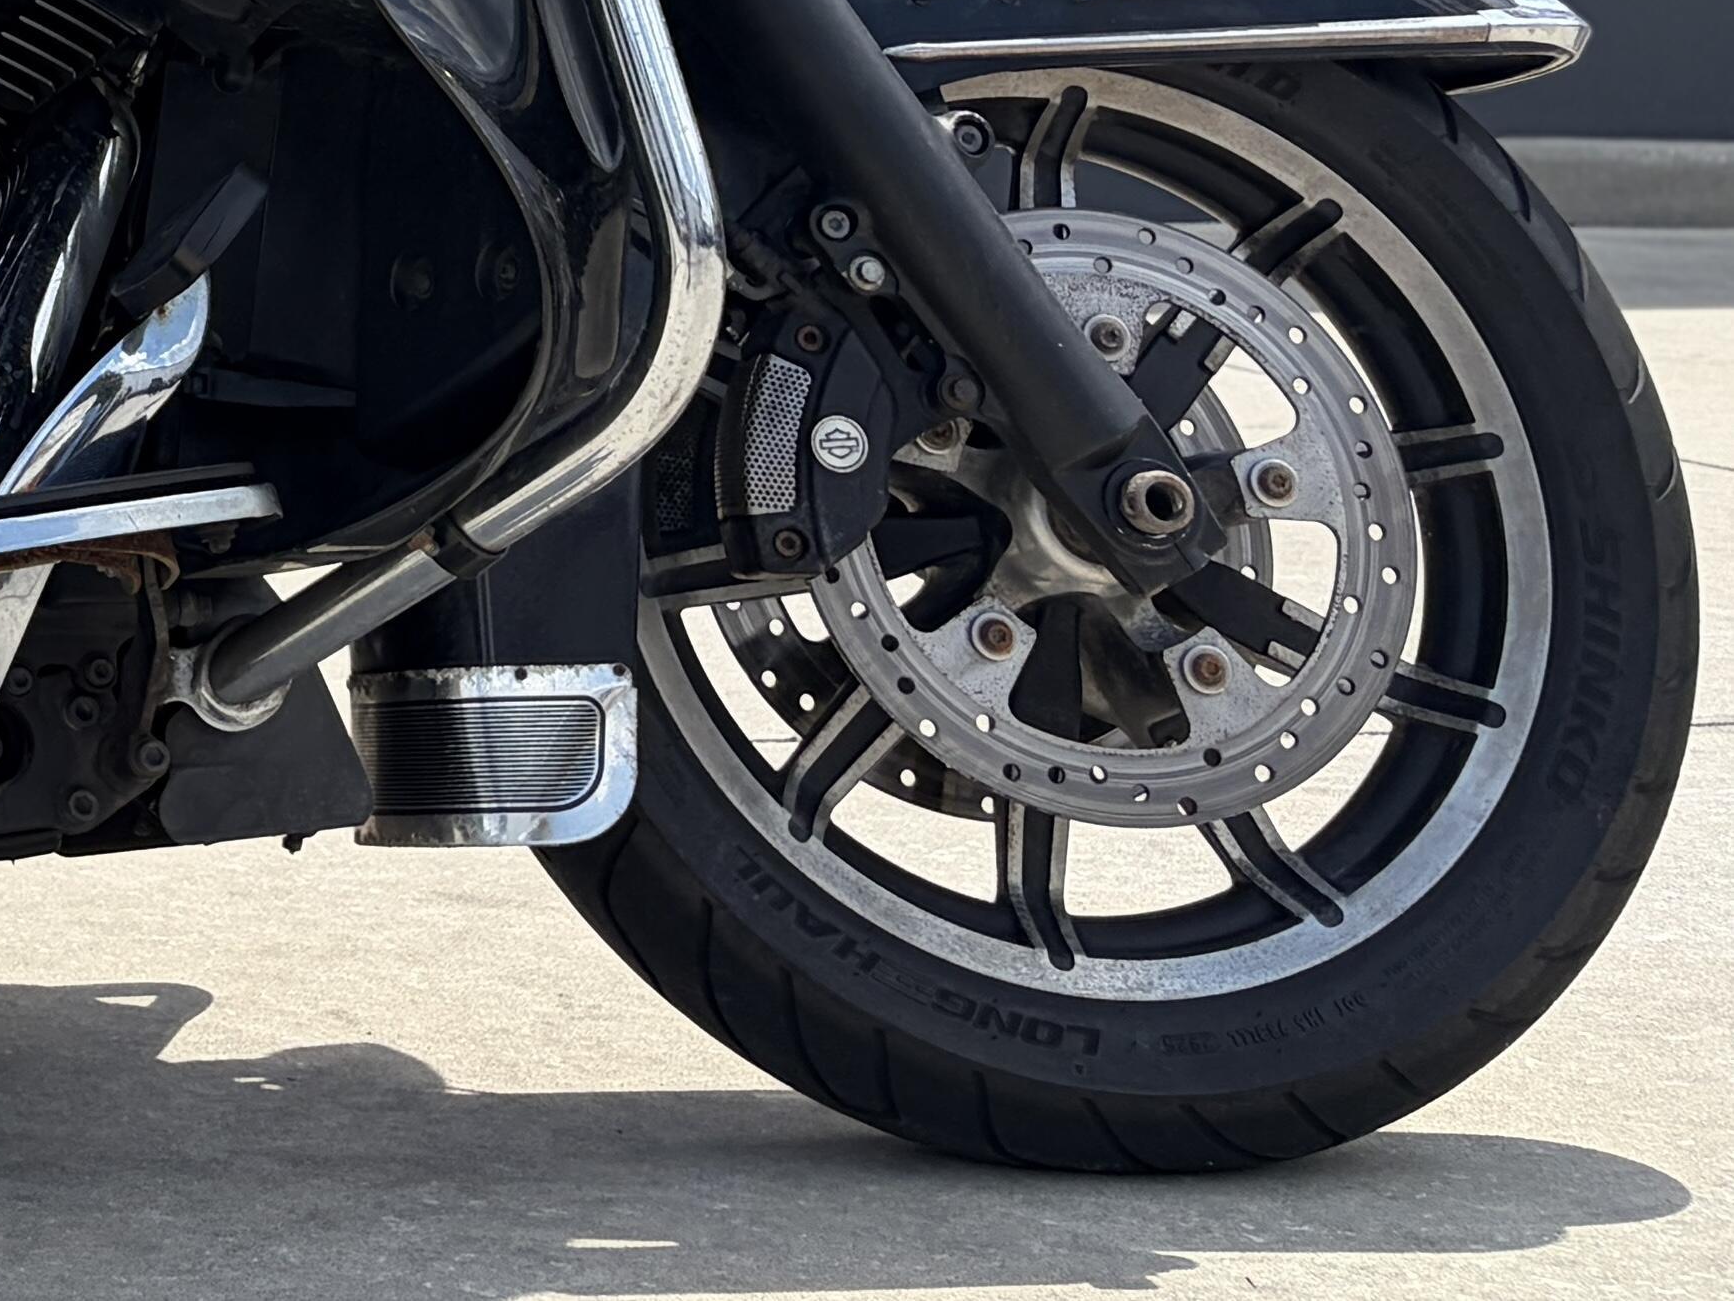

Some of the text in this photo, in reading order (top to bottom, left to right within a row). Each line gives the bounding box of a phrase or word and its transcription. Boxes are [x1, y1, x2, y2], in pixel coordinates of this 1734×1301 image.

[1545, 516, 1626, 799] SHINKO
[732, 847, 1103, 1057] LONG HAUL
